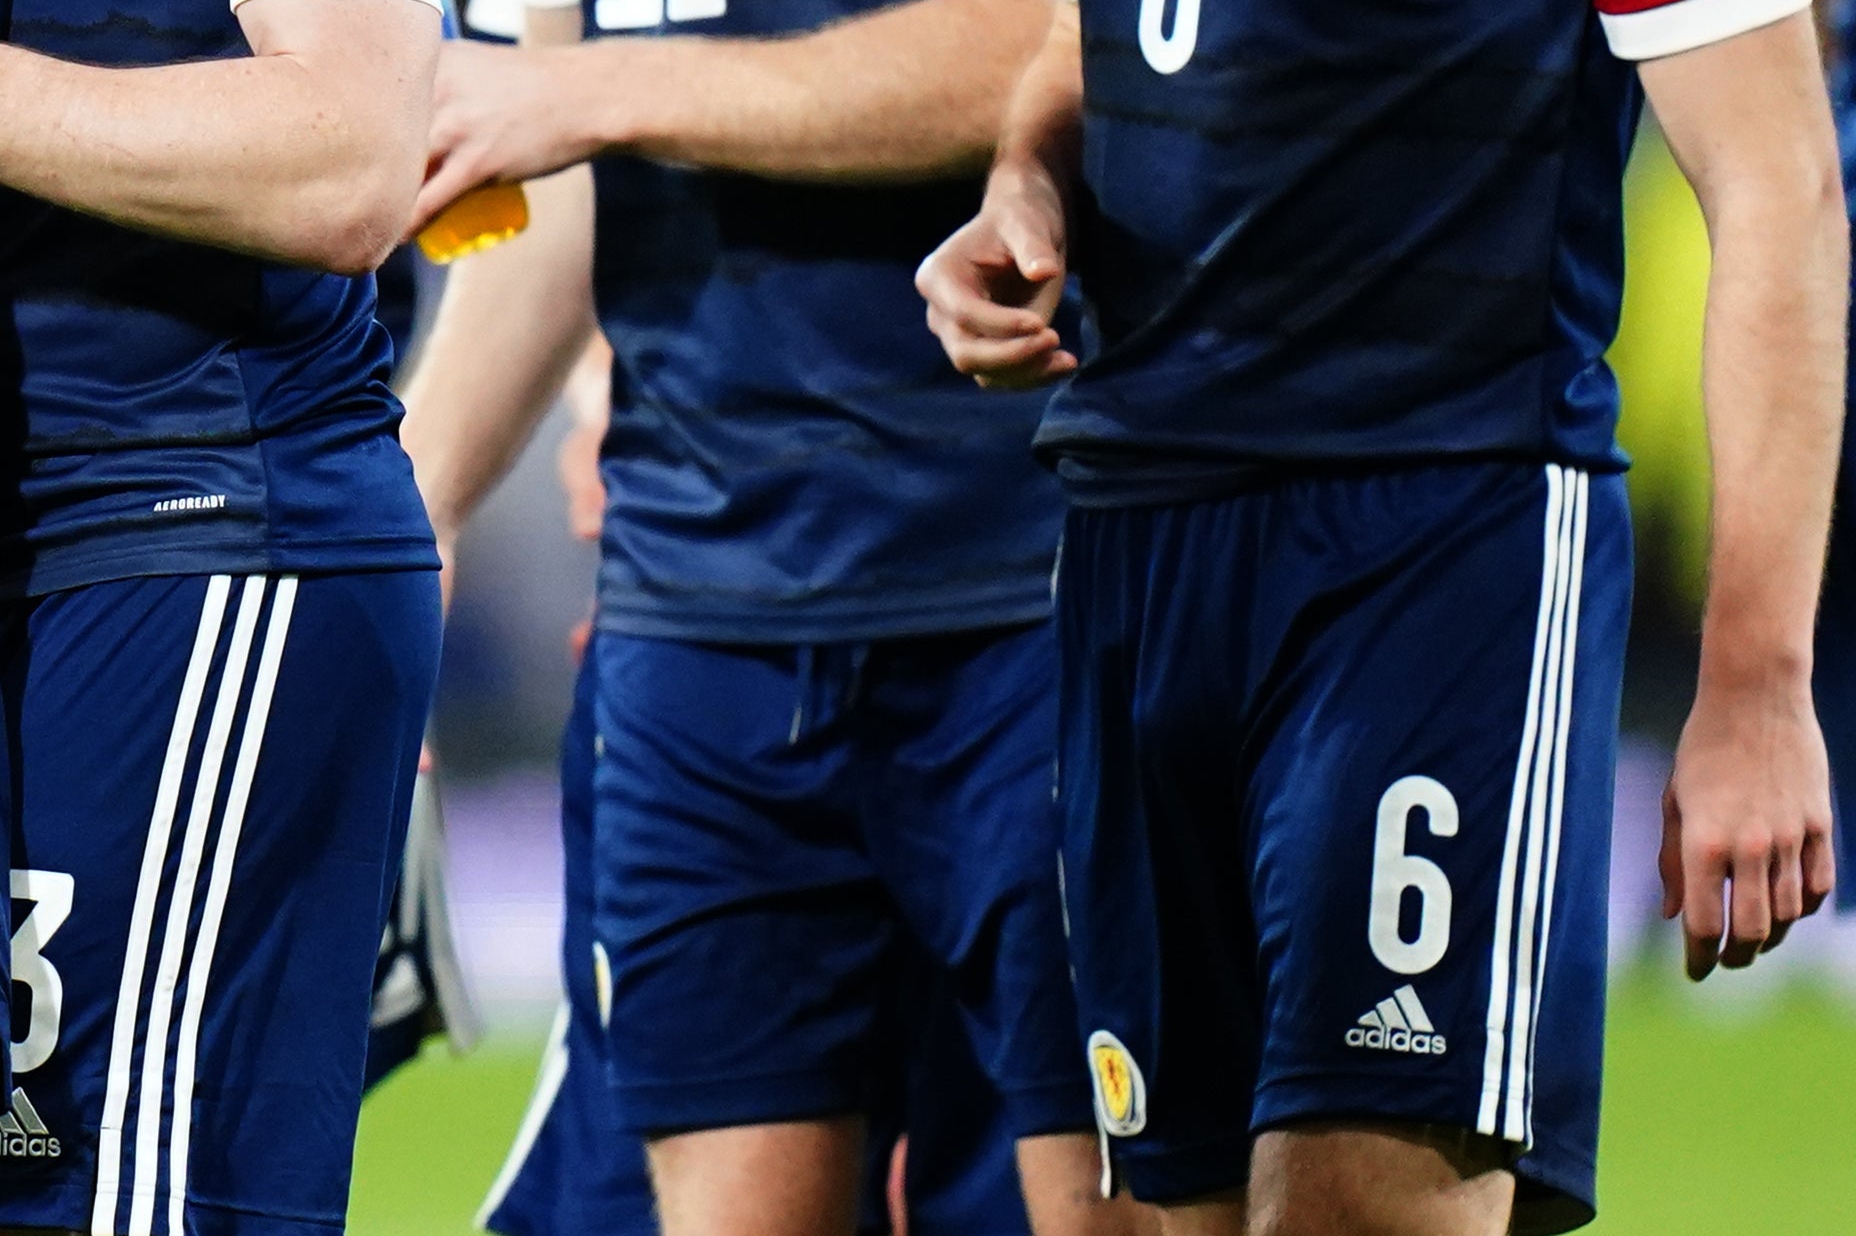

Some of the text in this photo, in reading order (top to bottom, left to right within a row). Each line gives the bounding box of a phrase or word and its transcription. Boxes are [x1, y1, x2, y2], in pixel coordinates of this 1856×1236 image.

[153, 494, 226, 513] AEROREADY
[1367, 774, 1460, 975] 6
[1344, 1024, 1448, 1056] adidas
